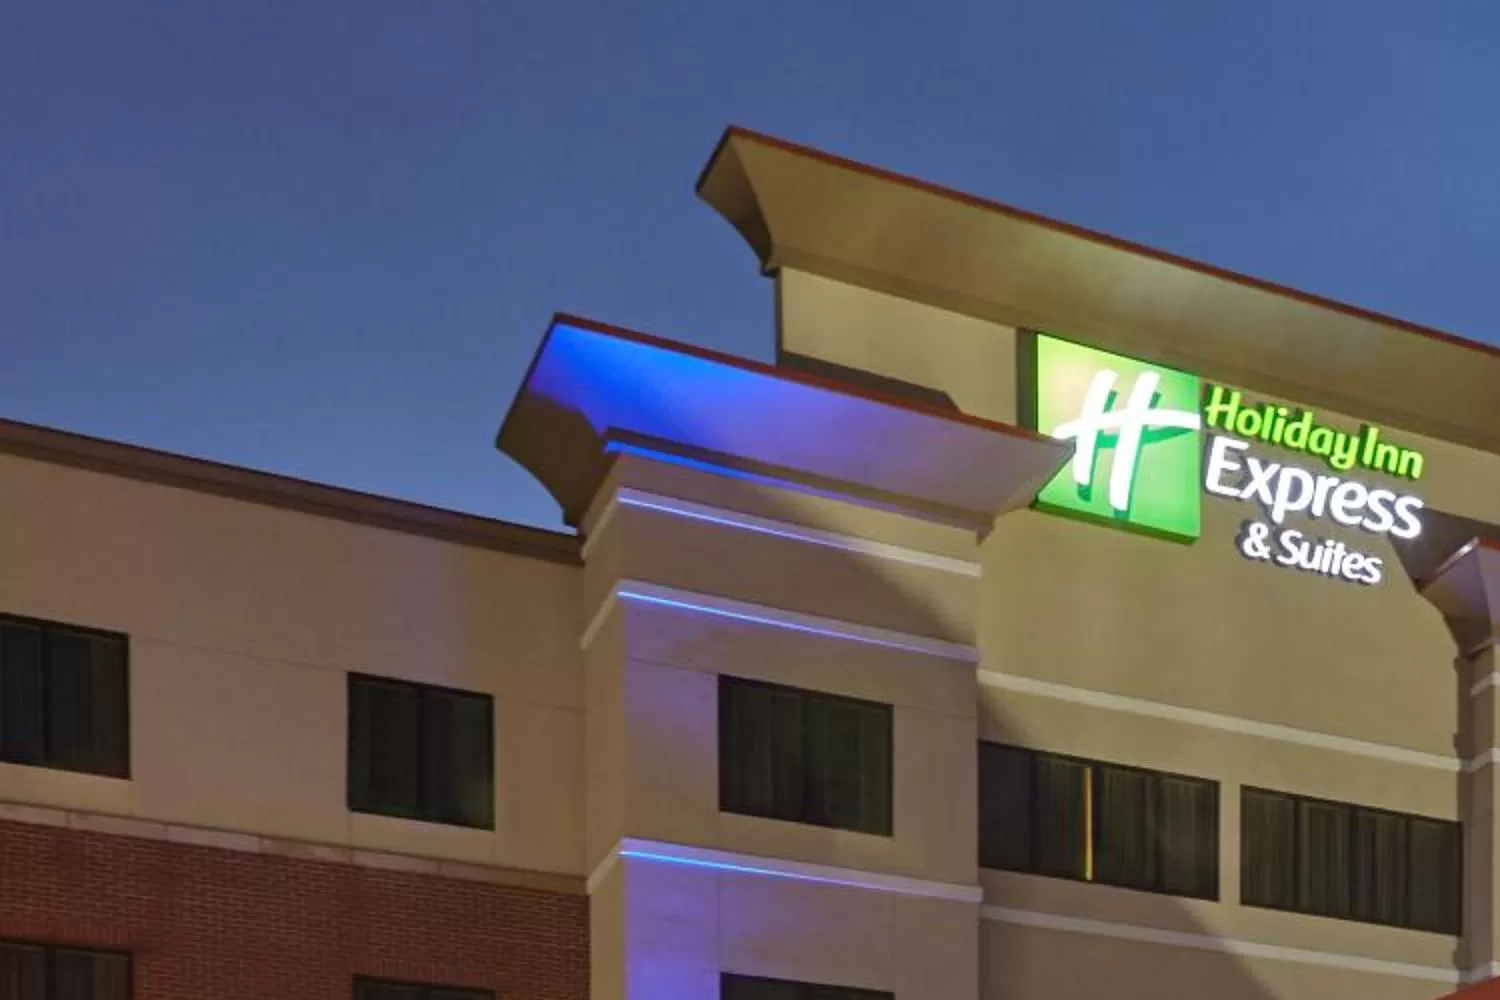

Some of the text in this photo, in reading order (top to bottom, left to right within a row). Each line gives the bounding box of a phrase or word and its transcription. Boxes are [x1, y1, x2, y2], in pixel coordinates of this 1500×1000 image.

[1205, 386, 1423, 479] Holiday Inn
[1205, 436, 1425, 539] Express
[1242, 522, 1382, 584] & Suites
